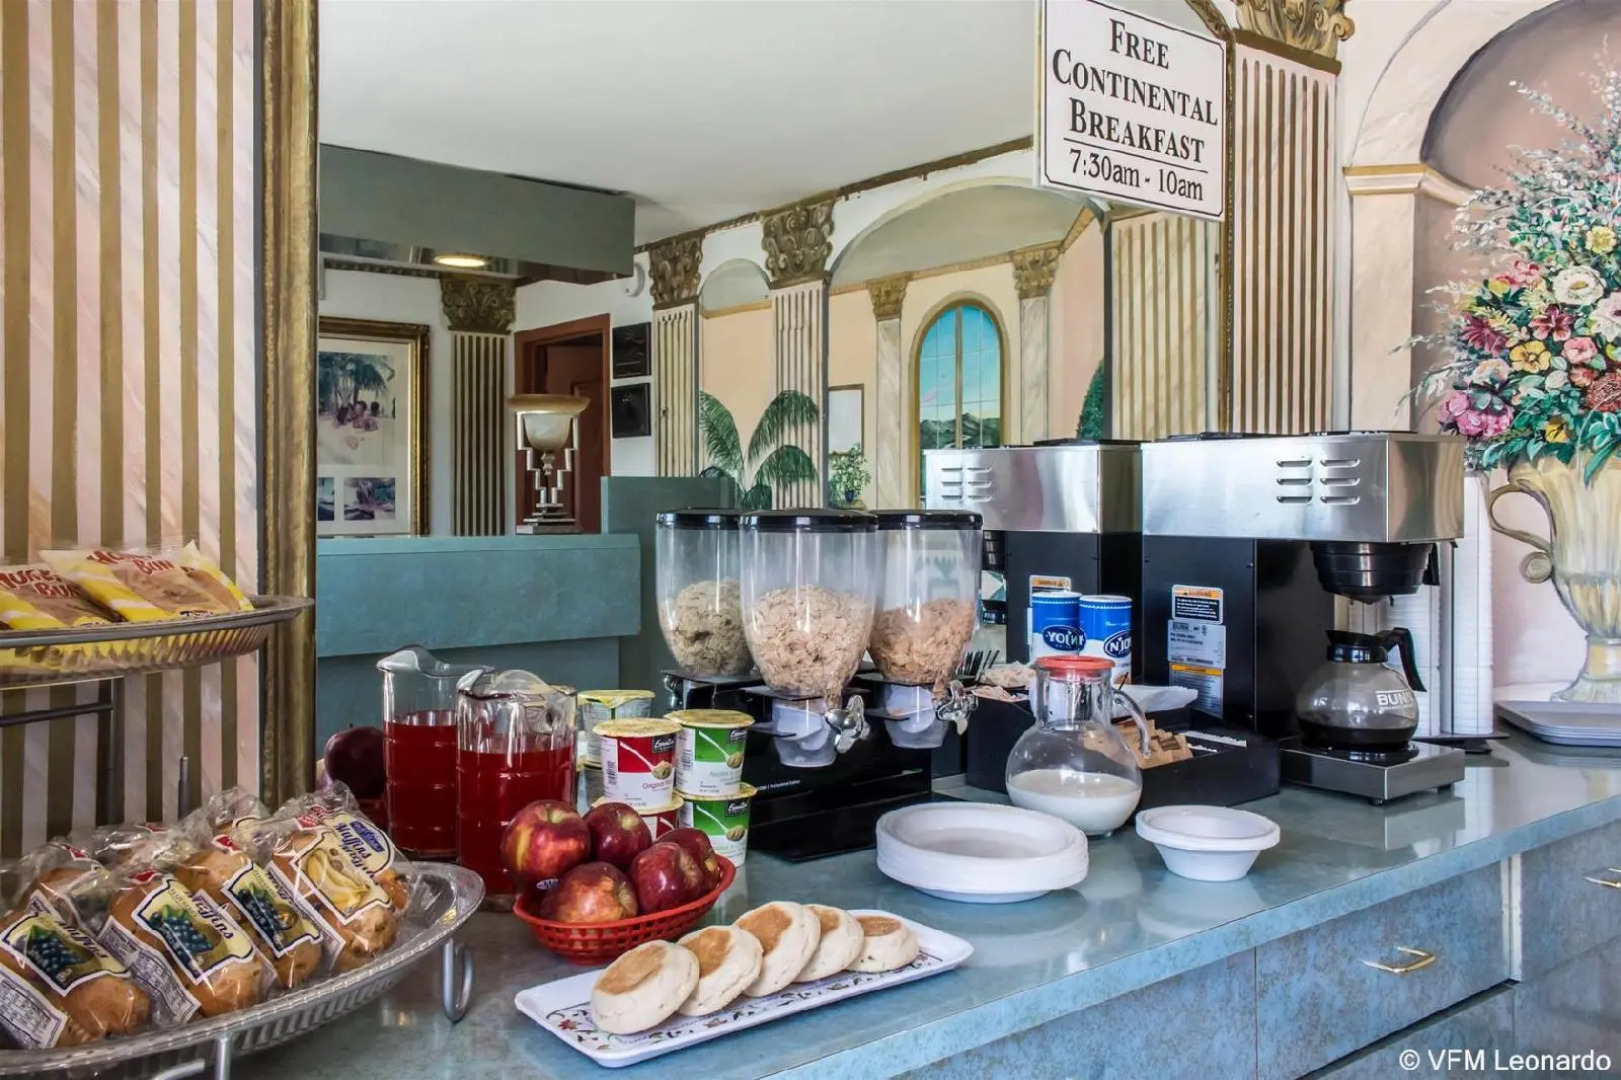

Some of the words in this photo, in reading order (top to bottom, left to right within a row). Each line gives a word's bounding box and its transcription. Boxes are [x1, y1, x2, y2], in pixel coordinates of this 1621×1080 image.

[1109, 18, 1169, 70] FREE
[1052, 48, 1218, 126] CONTINENTAL
[1069, 97, 1205, 163] BREAKFAST
[1069, 148, 1140, 188] 7:30am
[1158, 168, 1203, 201] 10am
[1109, 636, 1132, 652] N'JO
